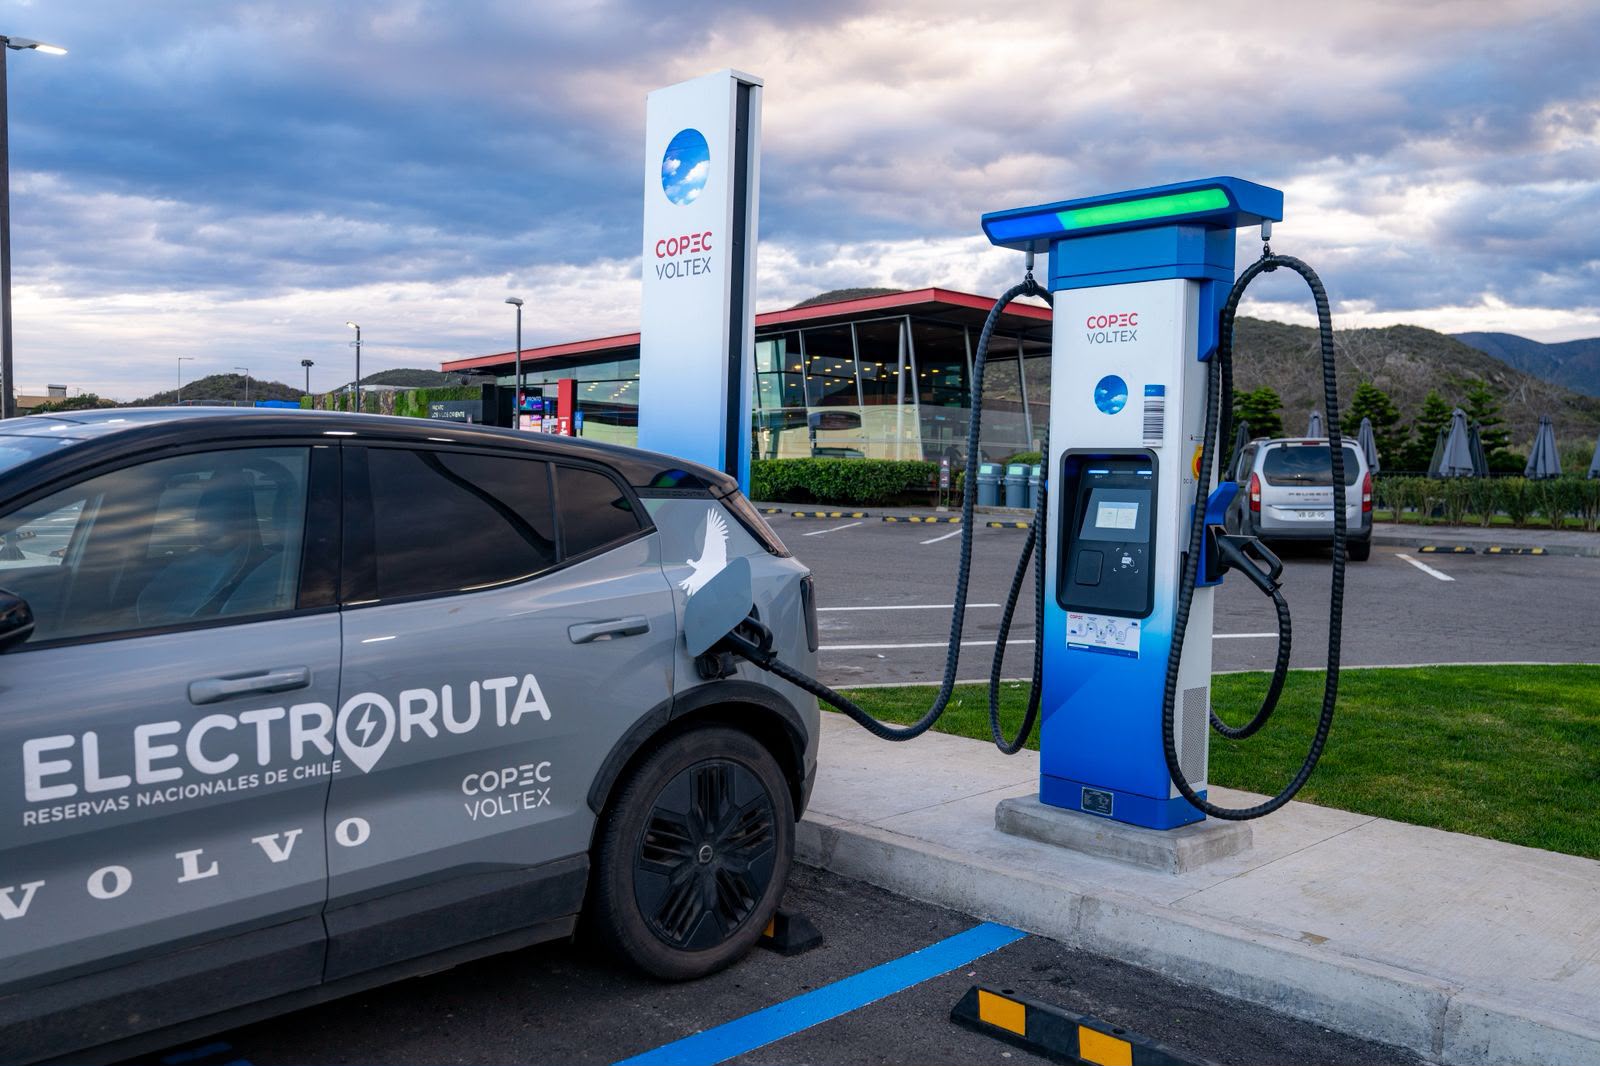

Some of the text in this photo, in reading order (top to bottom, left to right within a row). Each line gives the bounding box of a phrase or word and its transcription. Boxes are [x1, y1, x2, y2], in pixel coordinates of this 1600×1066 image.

[655, 231, 712, 258] COPEC
[655, 256, 712, 280] VOLTEX
[1086, 312, 1138, 329] COPEC
[1086, 329, 1137, 344] VOLTEX
[23, 760, 342, 826] RESERVAS NACIONALES DE CHILE
[462, 761, 551, 795] COPEC
[464, 787, 551, 821] VOLTEX
[0, 817, 371, 920] VOLVO
